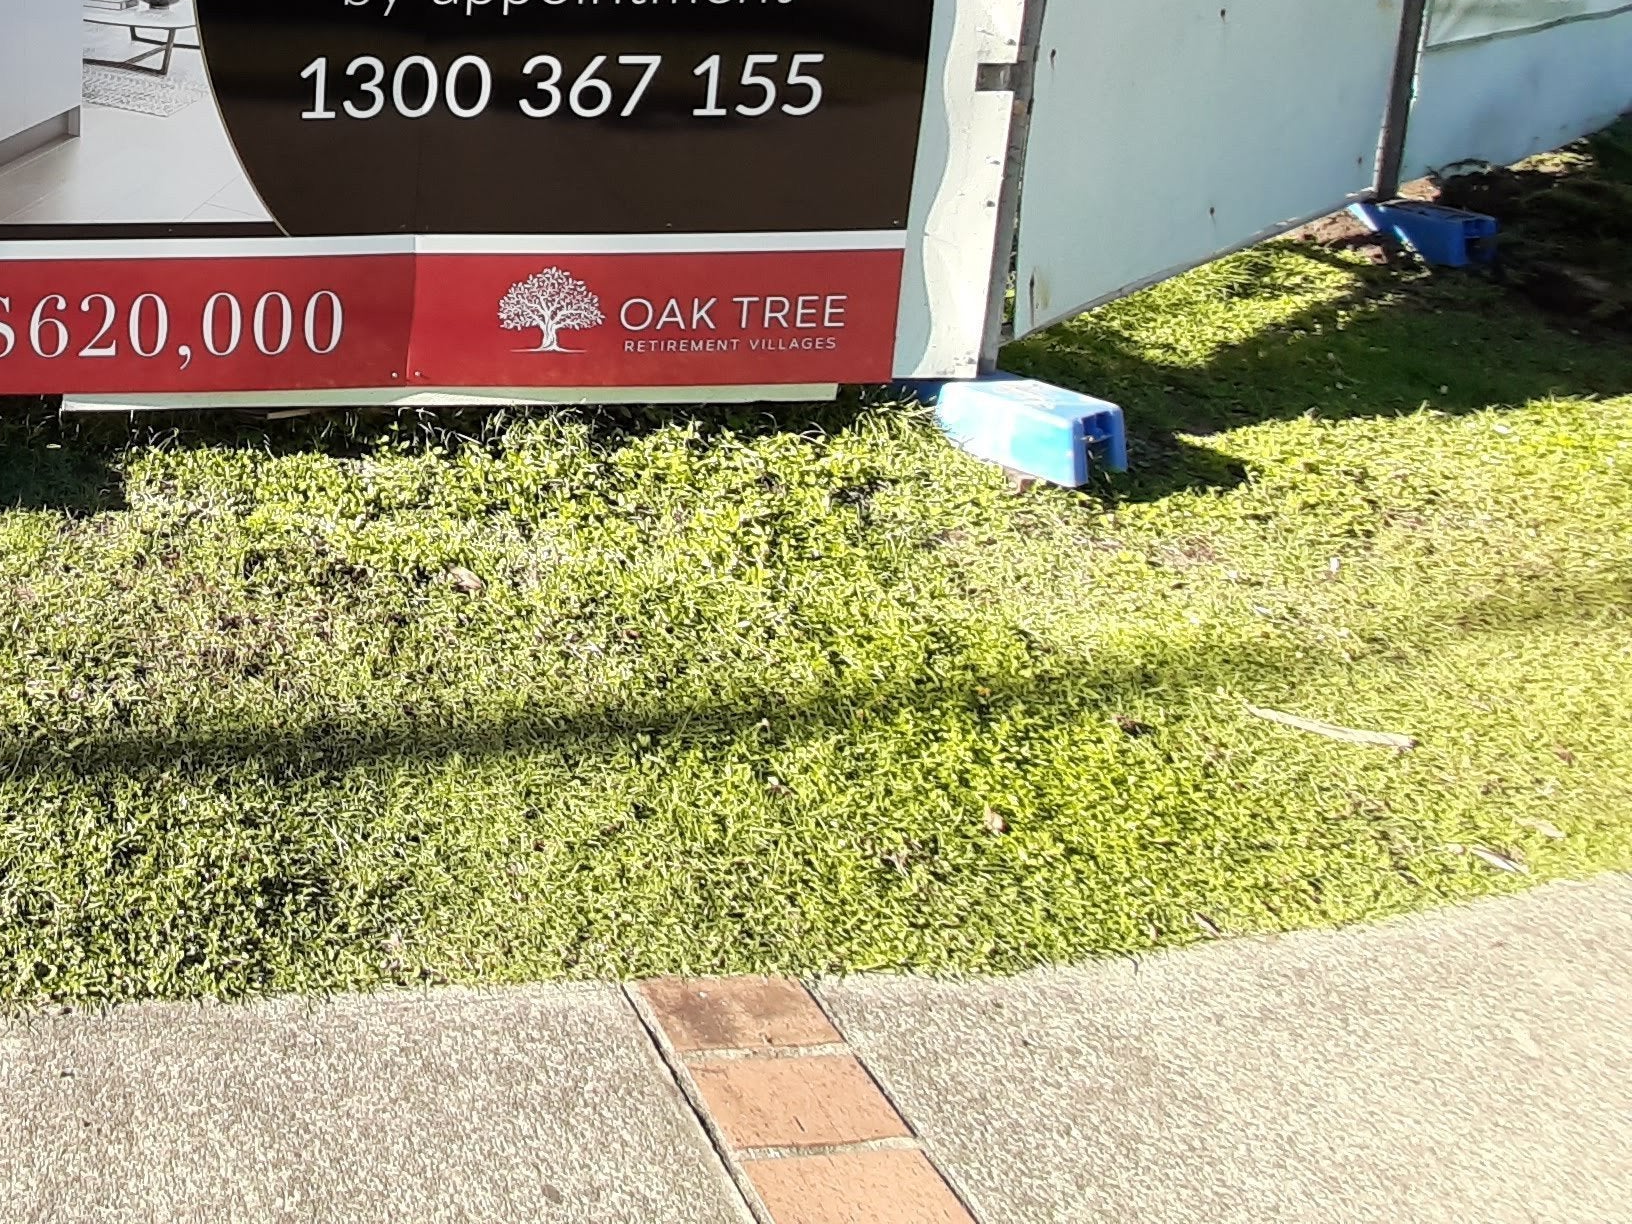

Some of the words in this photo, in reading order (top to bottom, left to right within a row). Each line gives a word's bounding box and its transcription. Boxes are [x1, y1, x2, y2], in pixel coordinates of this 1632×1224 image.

[299, 54, 492, 120] 1300
[517, 54, 662, 119] 367
[691, 52, 825, 117] 155
[619, 297, 717, 331] OAK
[732, 295, 848, 329] TREE
[623, 339, 741, 354] RETIREMENT
[749, 336, 837, 351] VILLAGES
